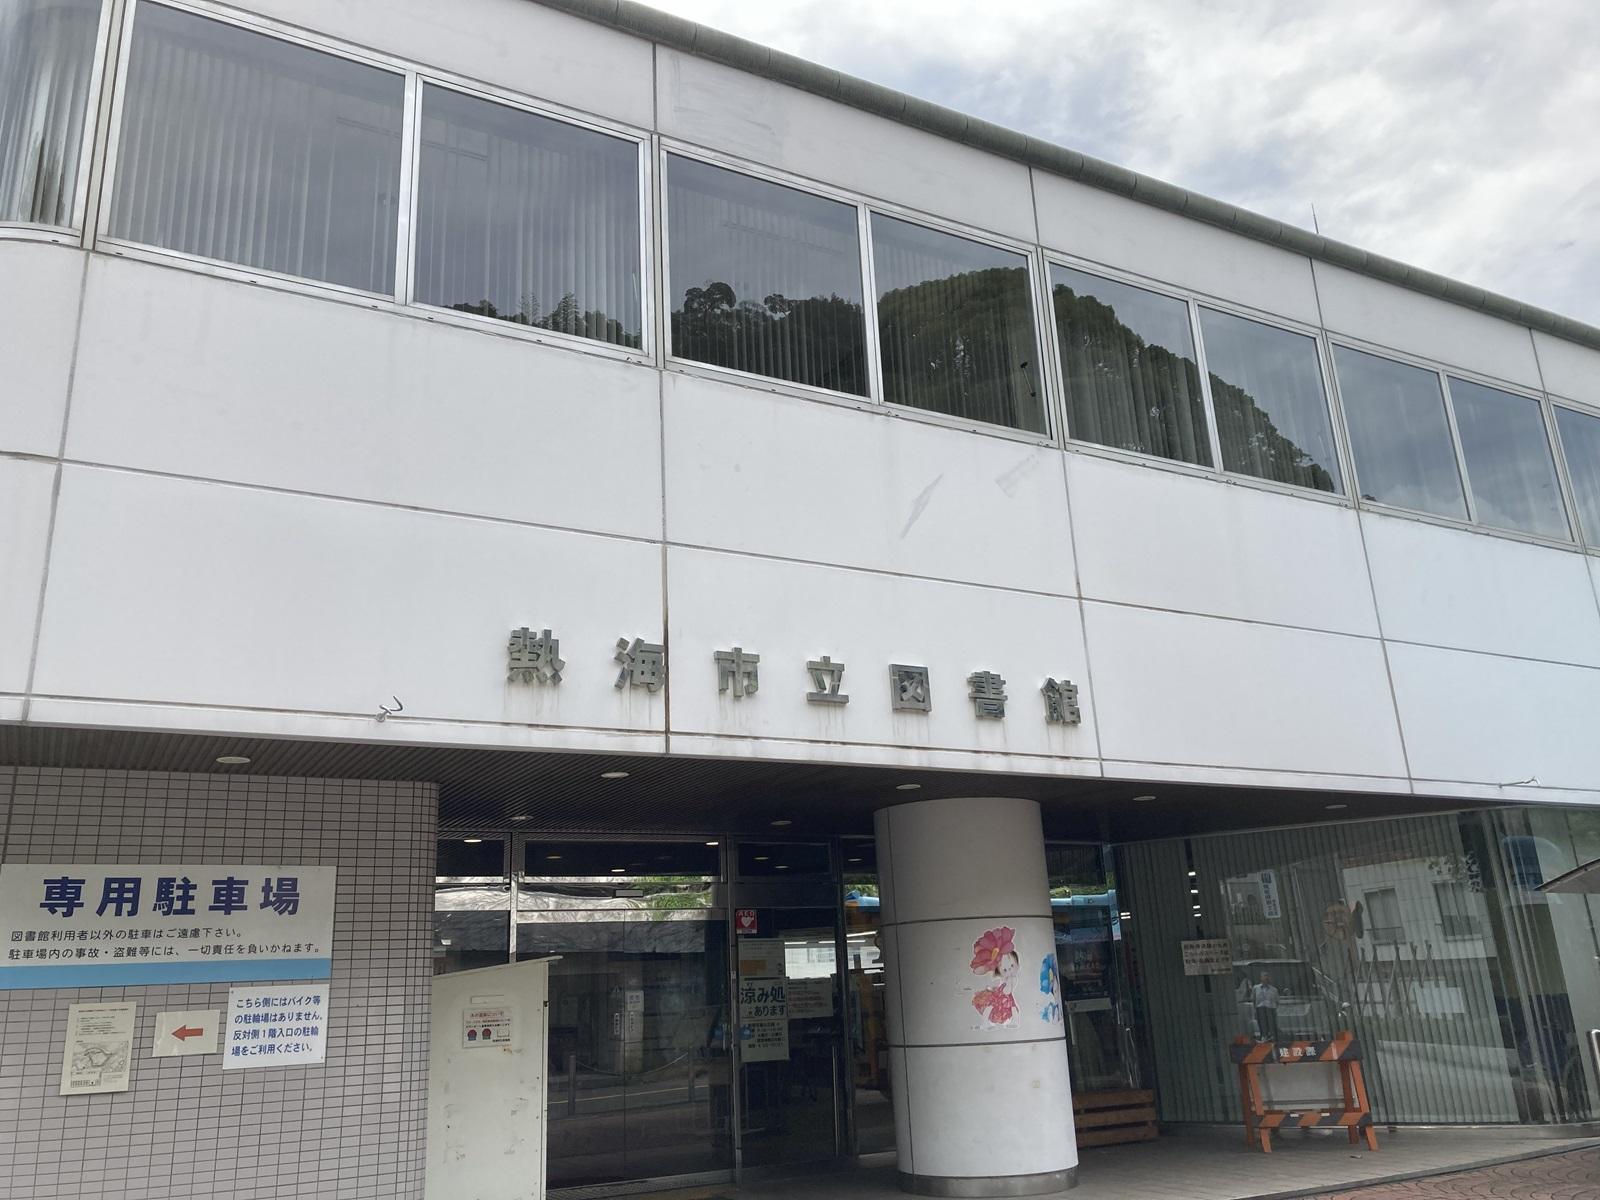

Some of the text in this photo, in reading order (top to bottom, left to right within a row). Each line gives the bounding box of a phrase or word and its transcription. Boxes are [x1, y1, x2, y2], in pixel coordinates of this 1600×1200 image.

[507, 627, 1081, 725] 熱海市立図書館
[39, 876, 300, 917] 専用駐車場
[10, 927, 242, 943] 図書館利用者以外の駐車はご遠慮下さい。
[8, 943, 319, 961] 駐車場内の事故・盗難等には、一切責任を負いかねます。
[236, 995, 321, 1008] こちら側にはバイク等
[740, 986, 786, 1004] 涼み処
[234, 1011, 323, 1024] の駐輪場はありません。
[753, 1005, 785, 1017] あります
[231, 1042, 313, 1057] 場をご利用ください。
